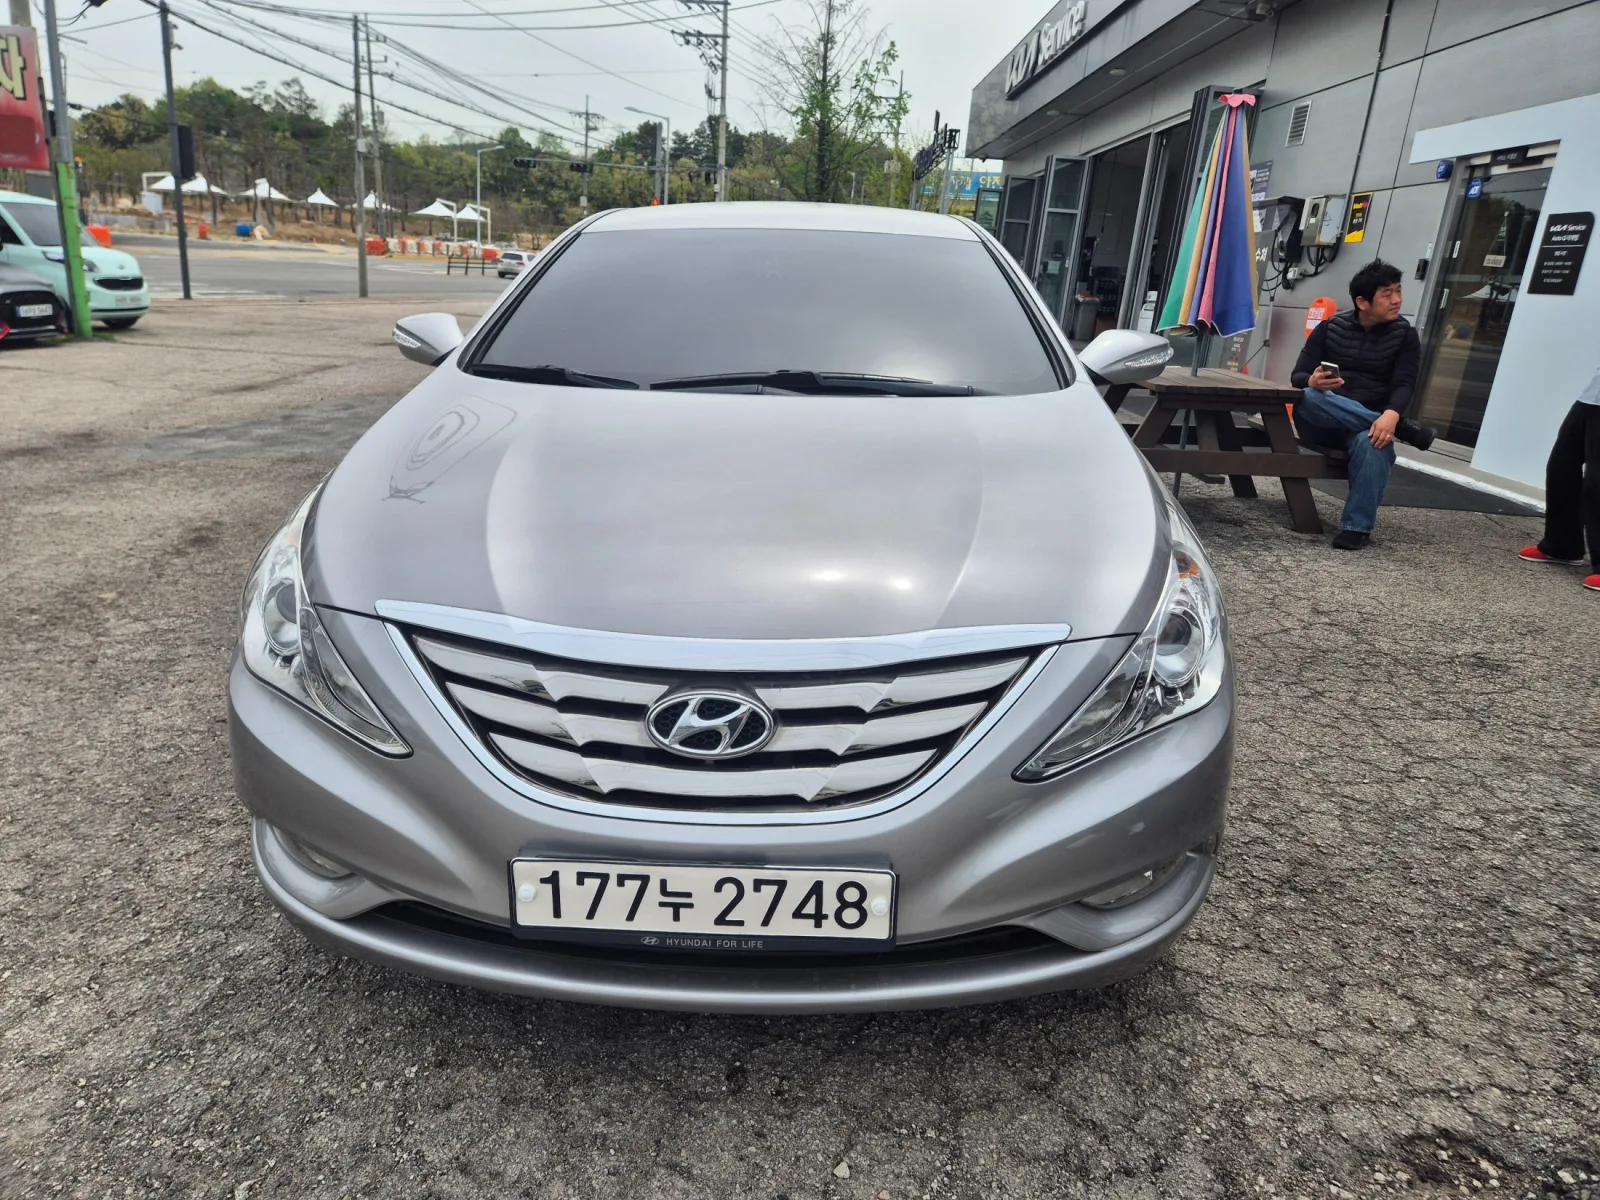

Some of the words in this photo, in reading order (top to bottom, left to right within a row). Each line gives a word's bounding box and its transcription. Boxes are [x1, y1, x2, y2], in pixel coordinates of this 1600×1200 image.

[1038, 0, 1086, 66] Service
[539, 870, 695, 922] 177누
[713, 876, 868, 929] 2748
[666, 938, 711, 947] HYUNDAI
[717, 940, 737, 948] FOR
[742, 940, 764, 949] LIFE
